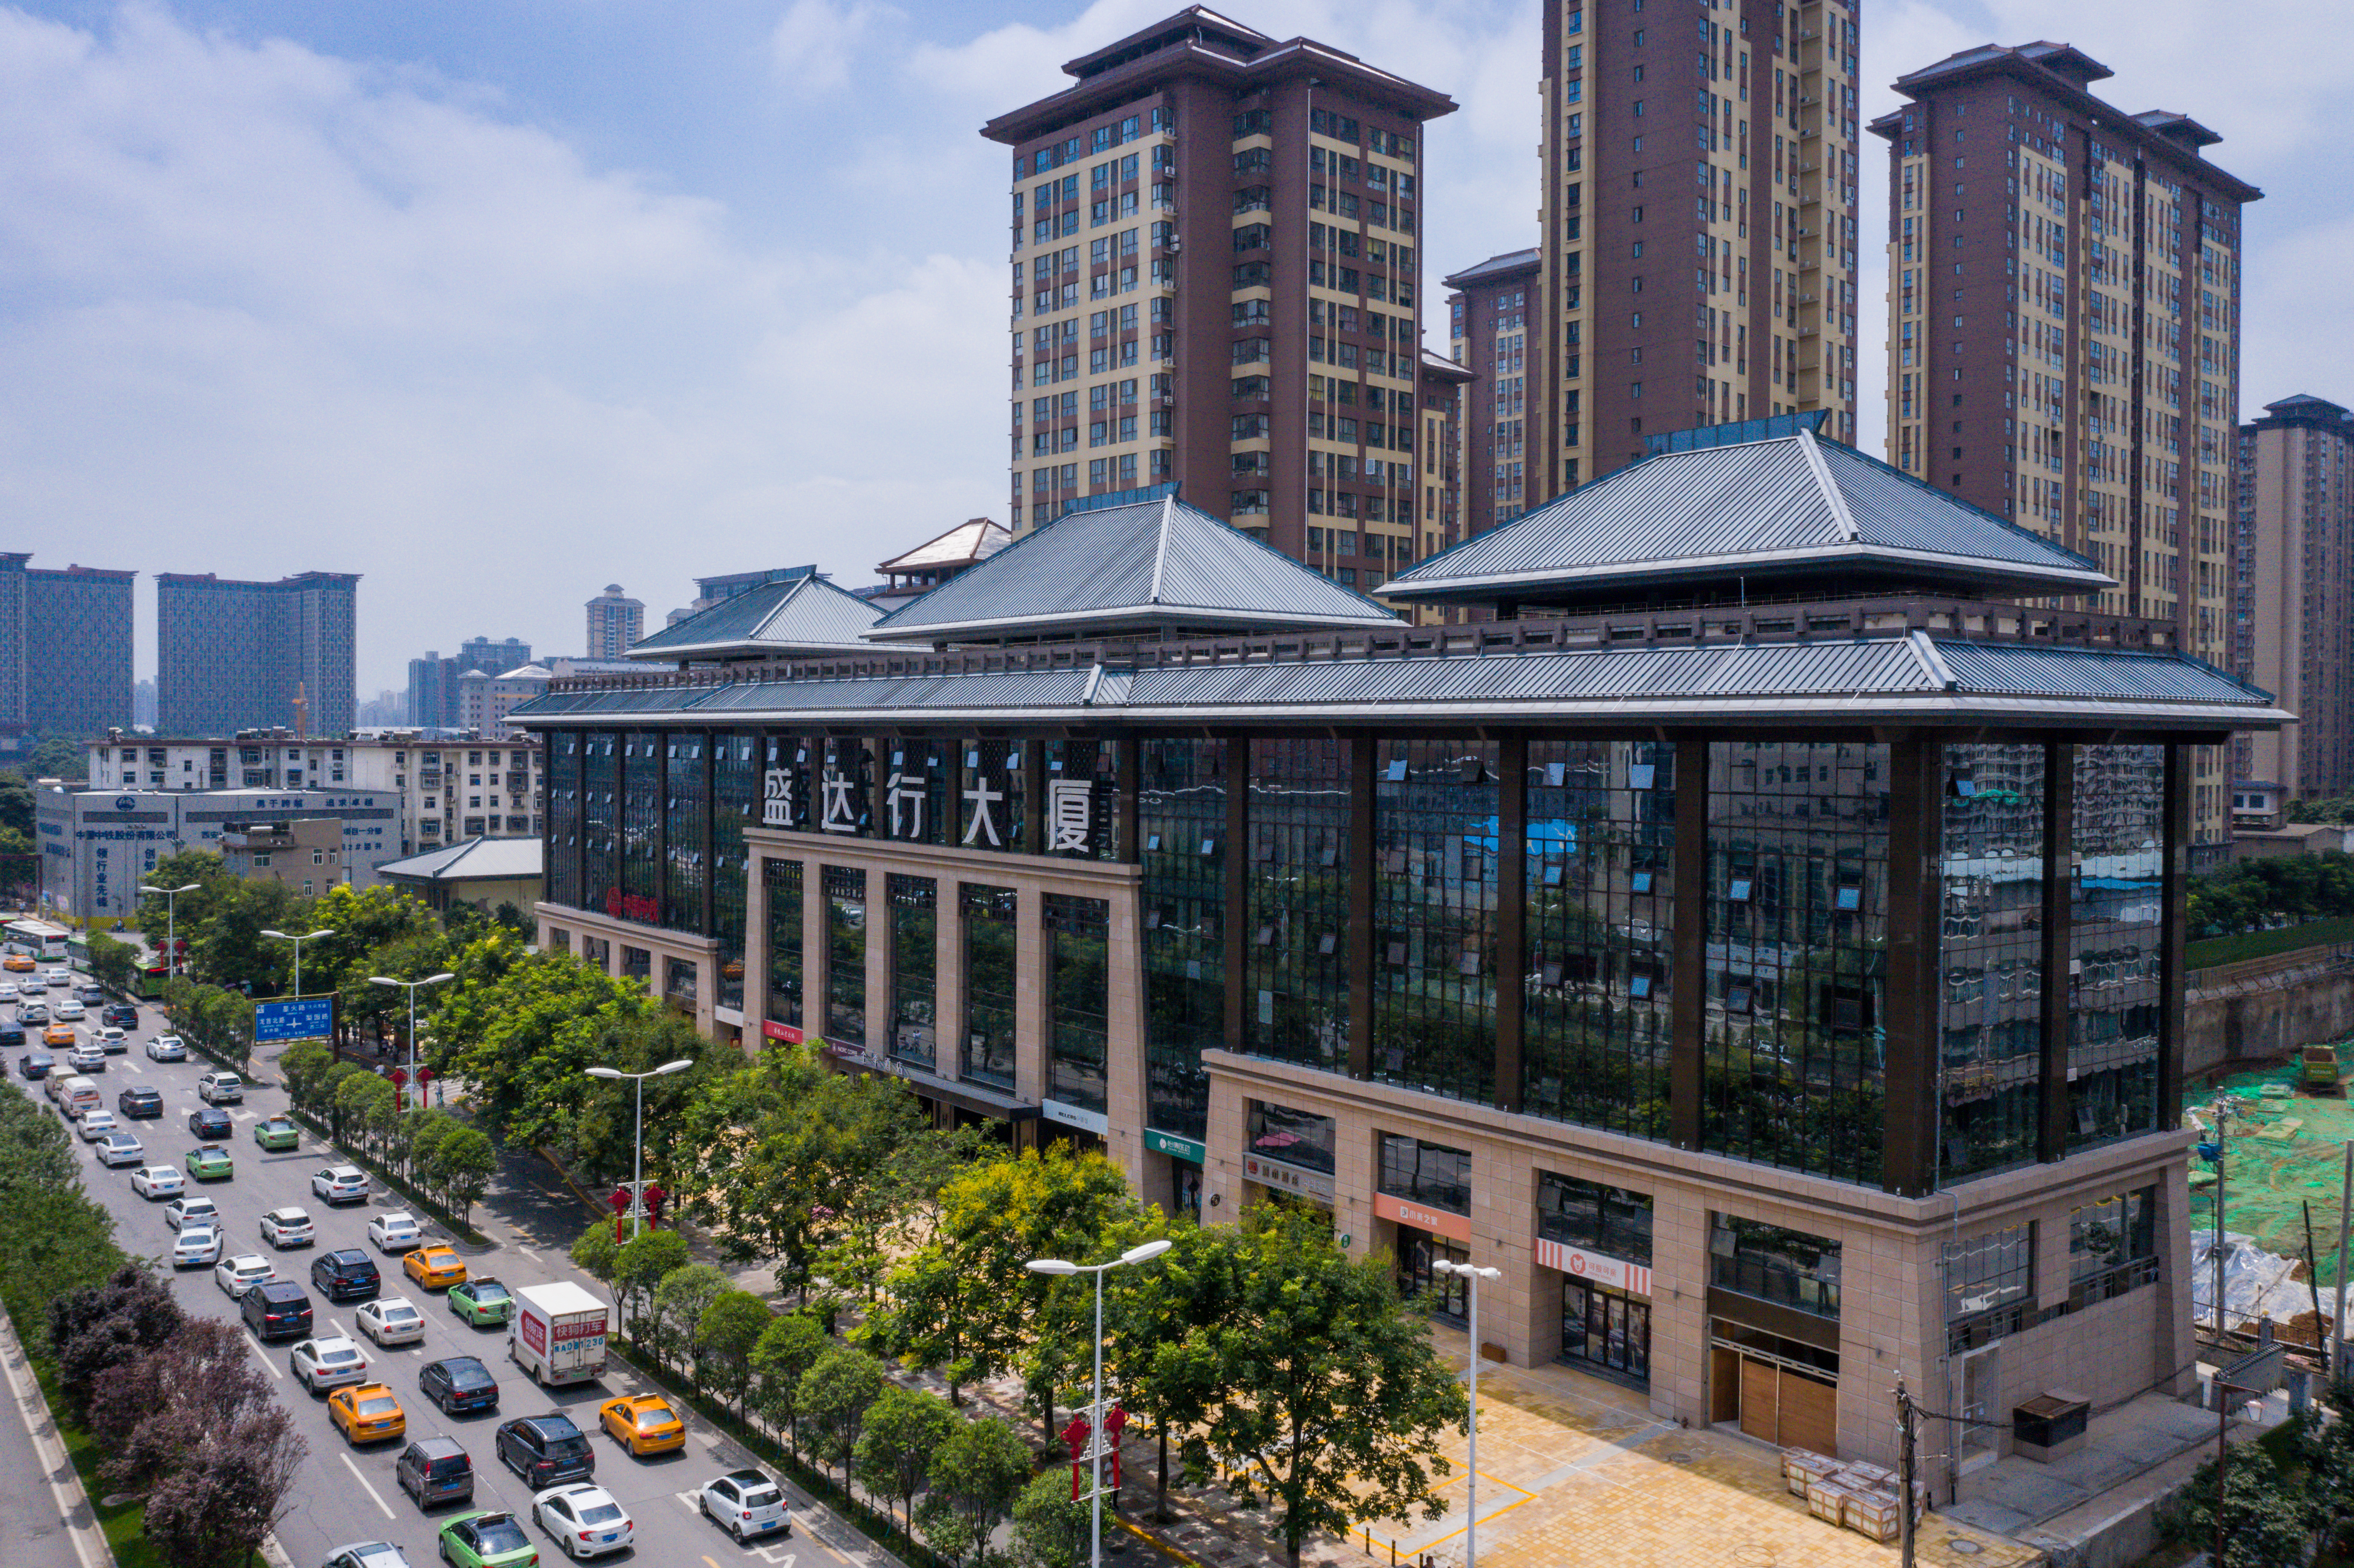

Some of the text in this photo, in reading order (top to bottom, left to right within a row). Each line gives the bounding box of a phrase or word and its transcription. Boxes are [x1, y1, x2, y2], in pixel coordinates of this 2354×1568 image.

[762, 768, 1092, 853] 盛达行大厦
[76, 830, 176, 840] 中国中铁股份有限公司
[623, 893, 659, 922] 中国中铁
[259, 1016, 285, 1025] 龙首北路
[861, 1051, 903, 1075] 全季酒店
[1409, 1210, 1438, 1226] 小米之家
[1588, 1261, 1617, 1278] 可爱可亲
[556, 1321, 602, 1338] 快狗打车
